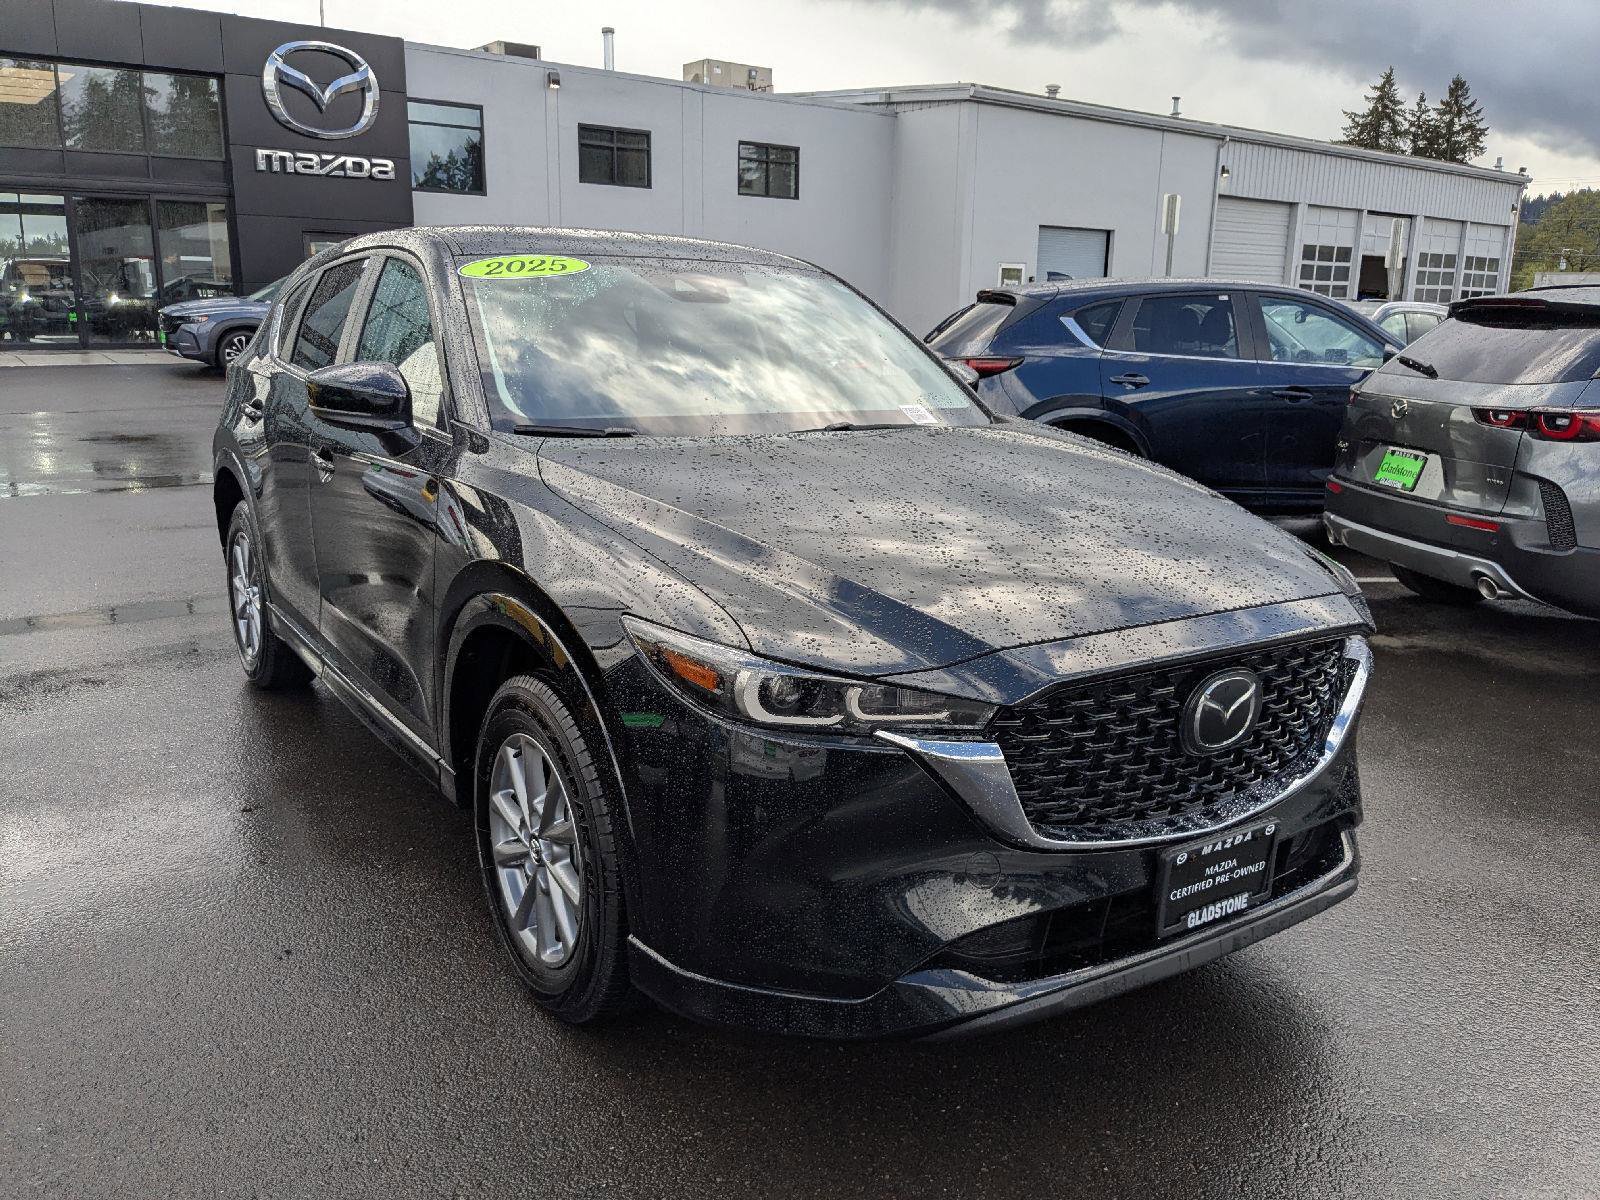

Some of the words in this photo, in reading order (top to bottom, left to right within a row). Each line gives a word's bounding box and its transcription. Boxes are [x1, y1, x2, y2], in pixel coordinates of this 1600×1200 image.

[485, 258, 568, 276] 2025
[1381, 462, 1417, 478] Gladstone
[1201, 832, 1252, 855] MAZDA
[1204, 858, 1237, 877] MAZDA
[1170, 878, 1213, 901] CERTIFIED
[1215, 860, 1266, 885] PRE-OWNED
[1187, 892, 1249, 928] GLADSTONE
